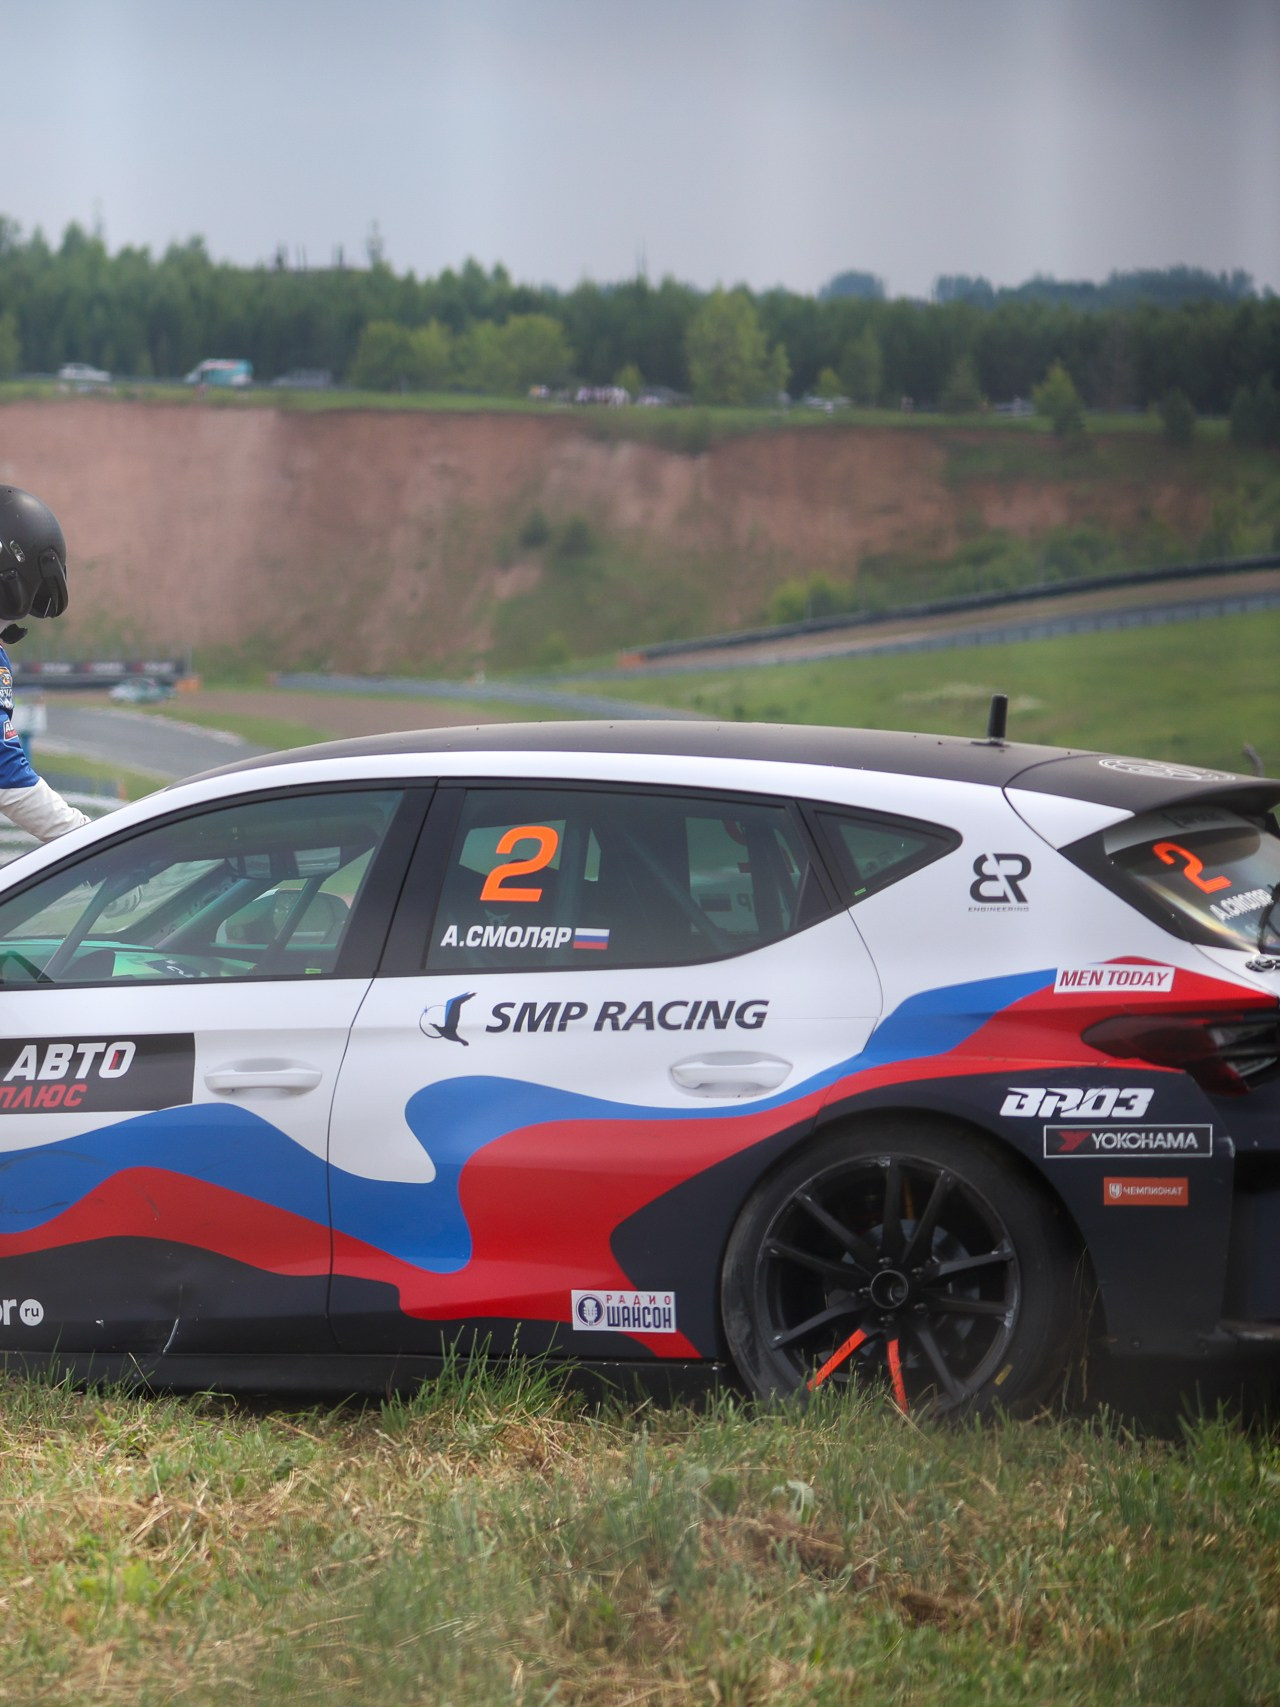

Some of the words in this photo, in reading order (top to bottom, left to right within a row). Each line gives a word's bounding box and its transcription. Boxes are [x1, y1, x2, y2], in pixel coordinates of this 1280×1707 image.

[479, 826, 559, 903] 2
[1152, 842, 1232, 894] 2
[440, 925, 572, 949] А.СМОЛЯР
[1059, 969, 1101, 987] MEN
[1107, 970, 1169, 986] TODAY
[485, 1001, 588, 1033] SMP
[593, 999, 770, 1032] RACING
[3, 1041, 136, 1082] АВТО
[1091, 1131, 1198, 1150] YOKOHAMA
[1123, 1186, 1184, 1195] ЧЕМПИОНАТ
[606, 1294, 672, 1306] РАДИО
[24, 1306, 39, 1317] ru
[606, 1306, 672, 1328] ШАНСОН
